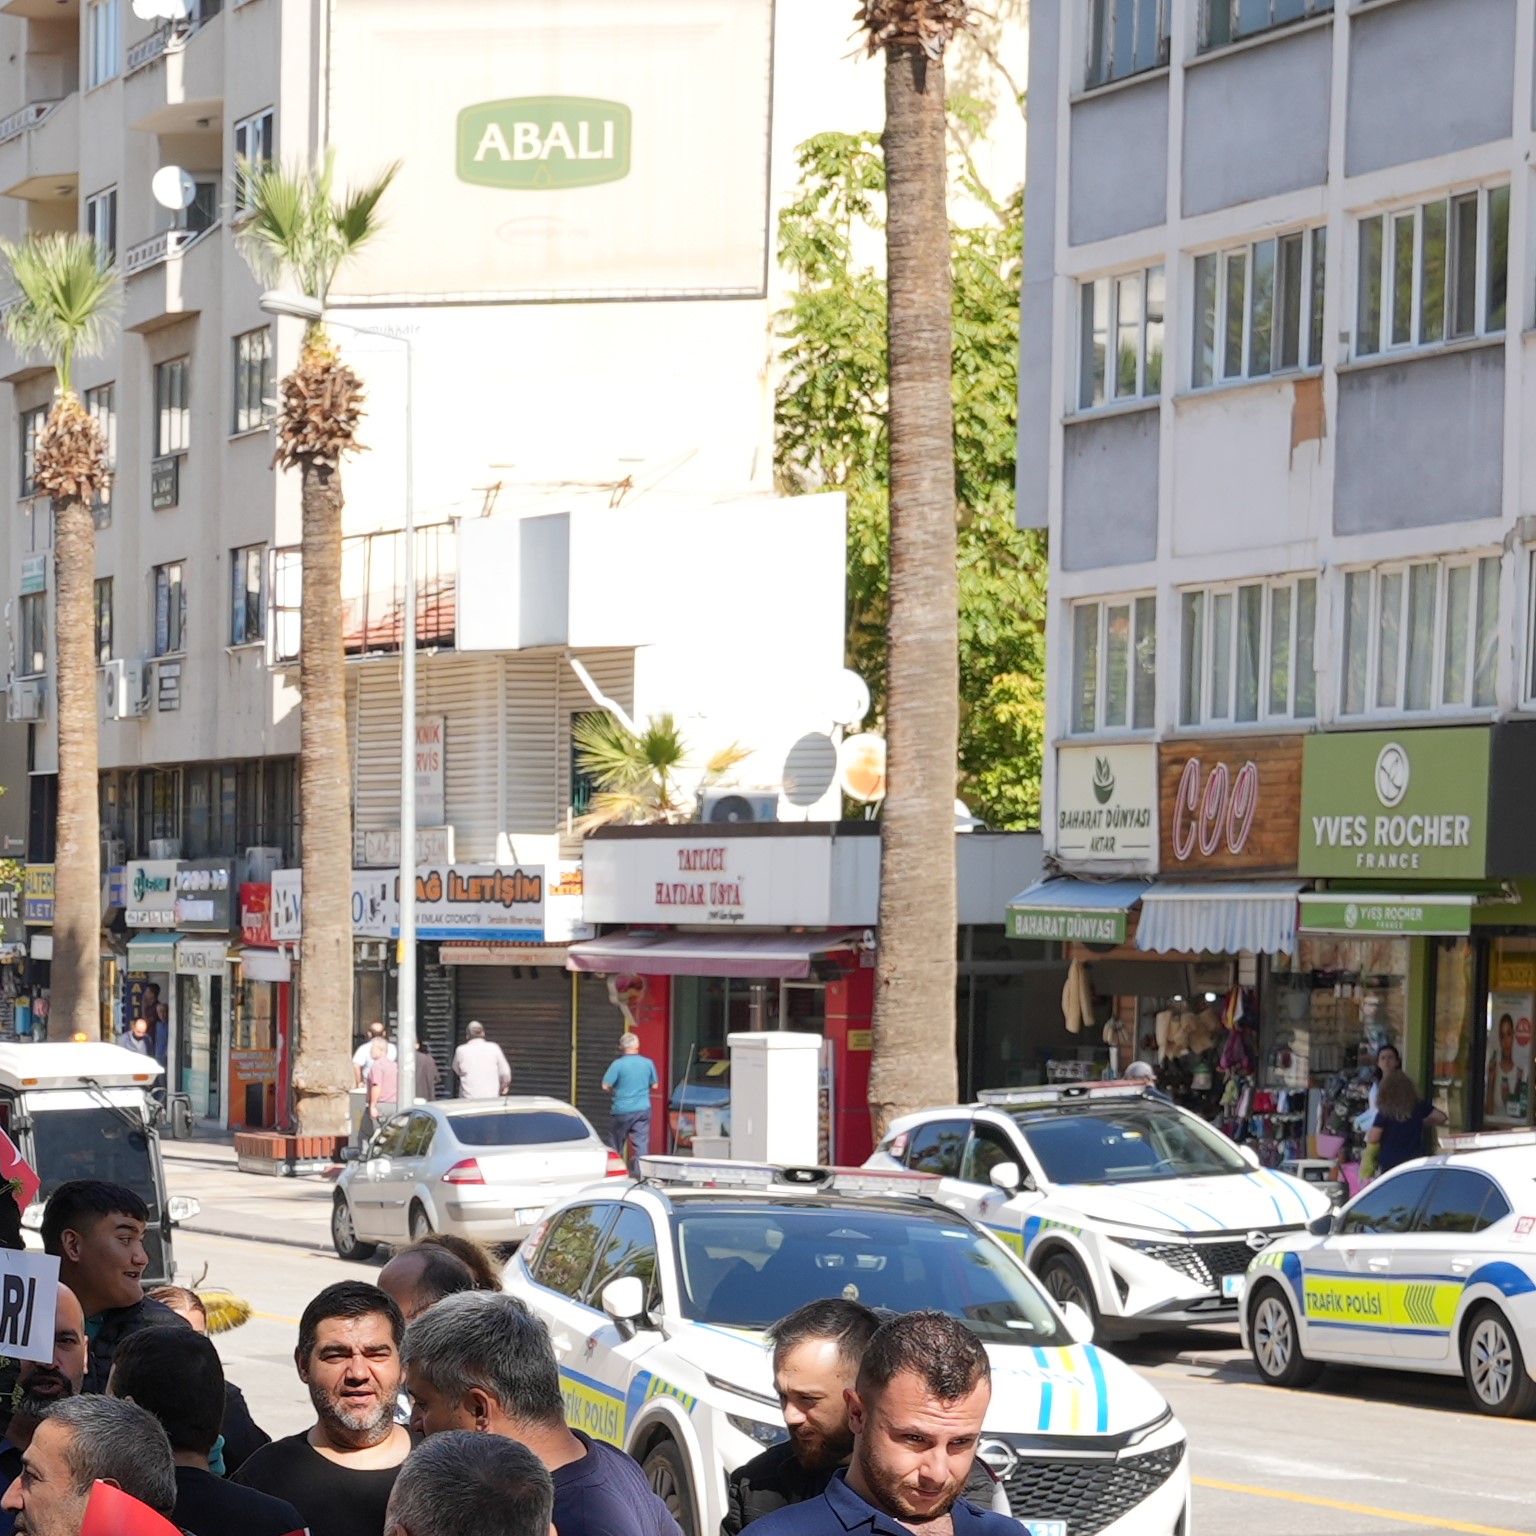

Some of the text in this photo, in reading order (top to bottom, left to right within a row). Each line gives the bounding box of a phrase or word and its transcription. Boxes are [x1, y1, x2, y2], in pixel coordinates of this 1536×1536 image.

[473, 120, 615, 163] ABALI
[416, 722, 440, 745] KNİK
[416, 752, 440, 772] RVİS
[1059, 804, 1152, 830] BAHARAT DÜNYASI
[1311, 814, 1472, 848] YVES ROCHER
[393, 834, 448, 860] İLTİŞİM
[1088, 836, 1116, 855] AKTAR
[677, 847, 726, 872] TATLICI
[1356, 853, 1421, 870] FRANCE
[447, 869, 542, 909] İLETİŞİM
[655, 882, 742, 907] HAYDAR USTA
[1015, 912, 1117, 940] BAHARAT DÜNYASI
[1359, 907, 1424, 922] YVES ROCHER
[1305, 1289, 1382, 1315] TRAFİK POLİSİ
[561, 1388, 620, 1440] FİK POLİSİ
